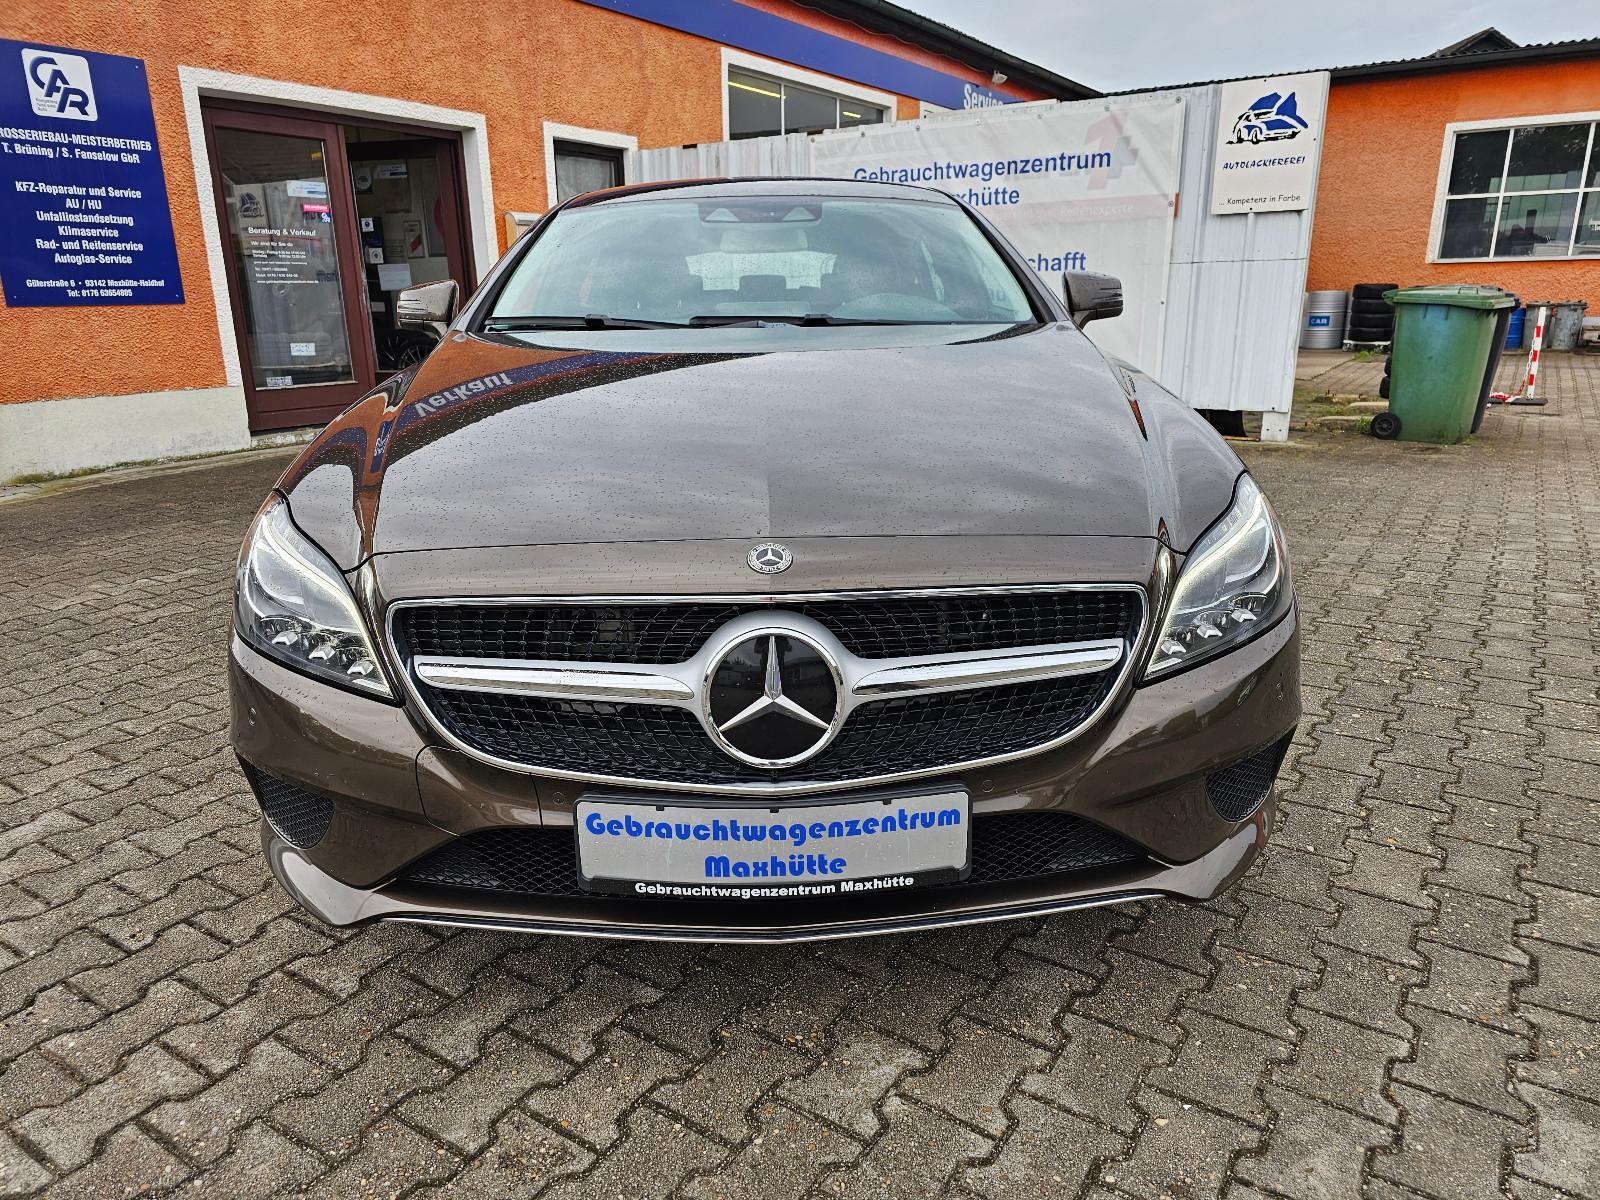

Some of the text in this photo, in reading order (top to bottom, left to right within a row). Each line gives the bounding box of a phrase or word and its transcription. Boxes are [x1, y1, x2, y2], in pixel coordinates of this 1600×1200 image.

[29, 55, 90, 116] CAR
[1, 142, 13, 153] T.
[14, 143, 53, 158] Brüning
[62, 147, 73, 158] S.
[75, 149, 118, 161] Fanselow
[121, 151, 140, 164] GbR
[853, 150, 1112, 183] Gebrauchtwagenzentrum
[1222, 156, 1306, 170] AUTOLACKIEREREI
[15, 181, 142, 199] KFZ-Reparatur und Service
[65, 198, 80, 209] AU
[88, 199, 102, 210] HU
[1227, 196, 1267, 206] Kompetenz
[1278, 194, 1301, 202] Farbe
[36, 211, 134, 227] Unfallinstandsetzung
[58, 226, 119, 238] Klimaservice
[248, 226, 281, 236] Beratung
[35, 239, 144, 251] Rad- und Reifenservice
[54, 253, 133, 265] Autoglas-Service
[585, 808, 961, 846] Gebrauchtwagenzentrum
[704, 853, 847, 878] Maxhütte
[635, 875, 914, 899] Gebrauchtwagenzentrum Maxhütte
